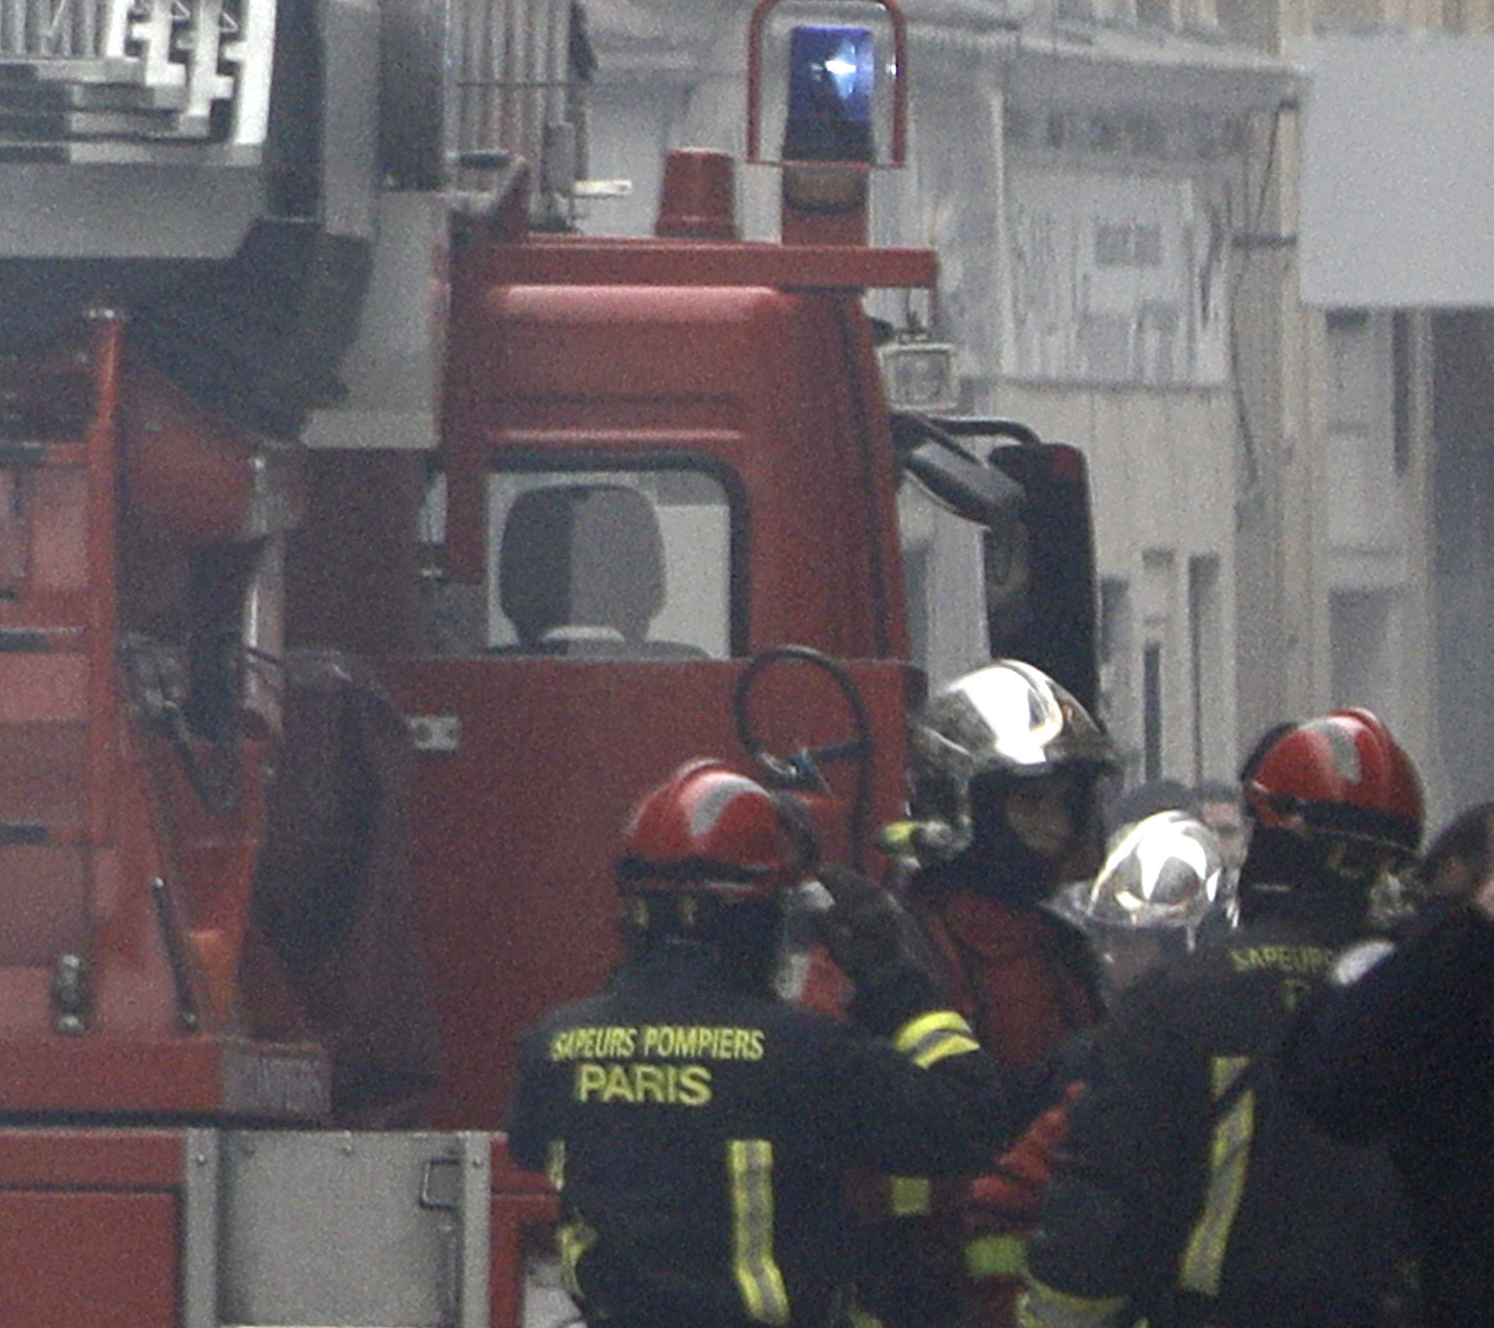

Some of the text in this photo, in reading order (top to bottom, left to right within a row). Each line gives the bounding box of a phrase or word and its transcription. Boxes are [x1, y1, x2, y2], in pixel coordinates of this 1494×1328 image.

[551, 1026, 766, 1061] SAPEURS POMPIERS
[578, 1064, 713, 1106] PARIS
